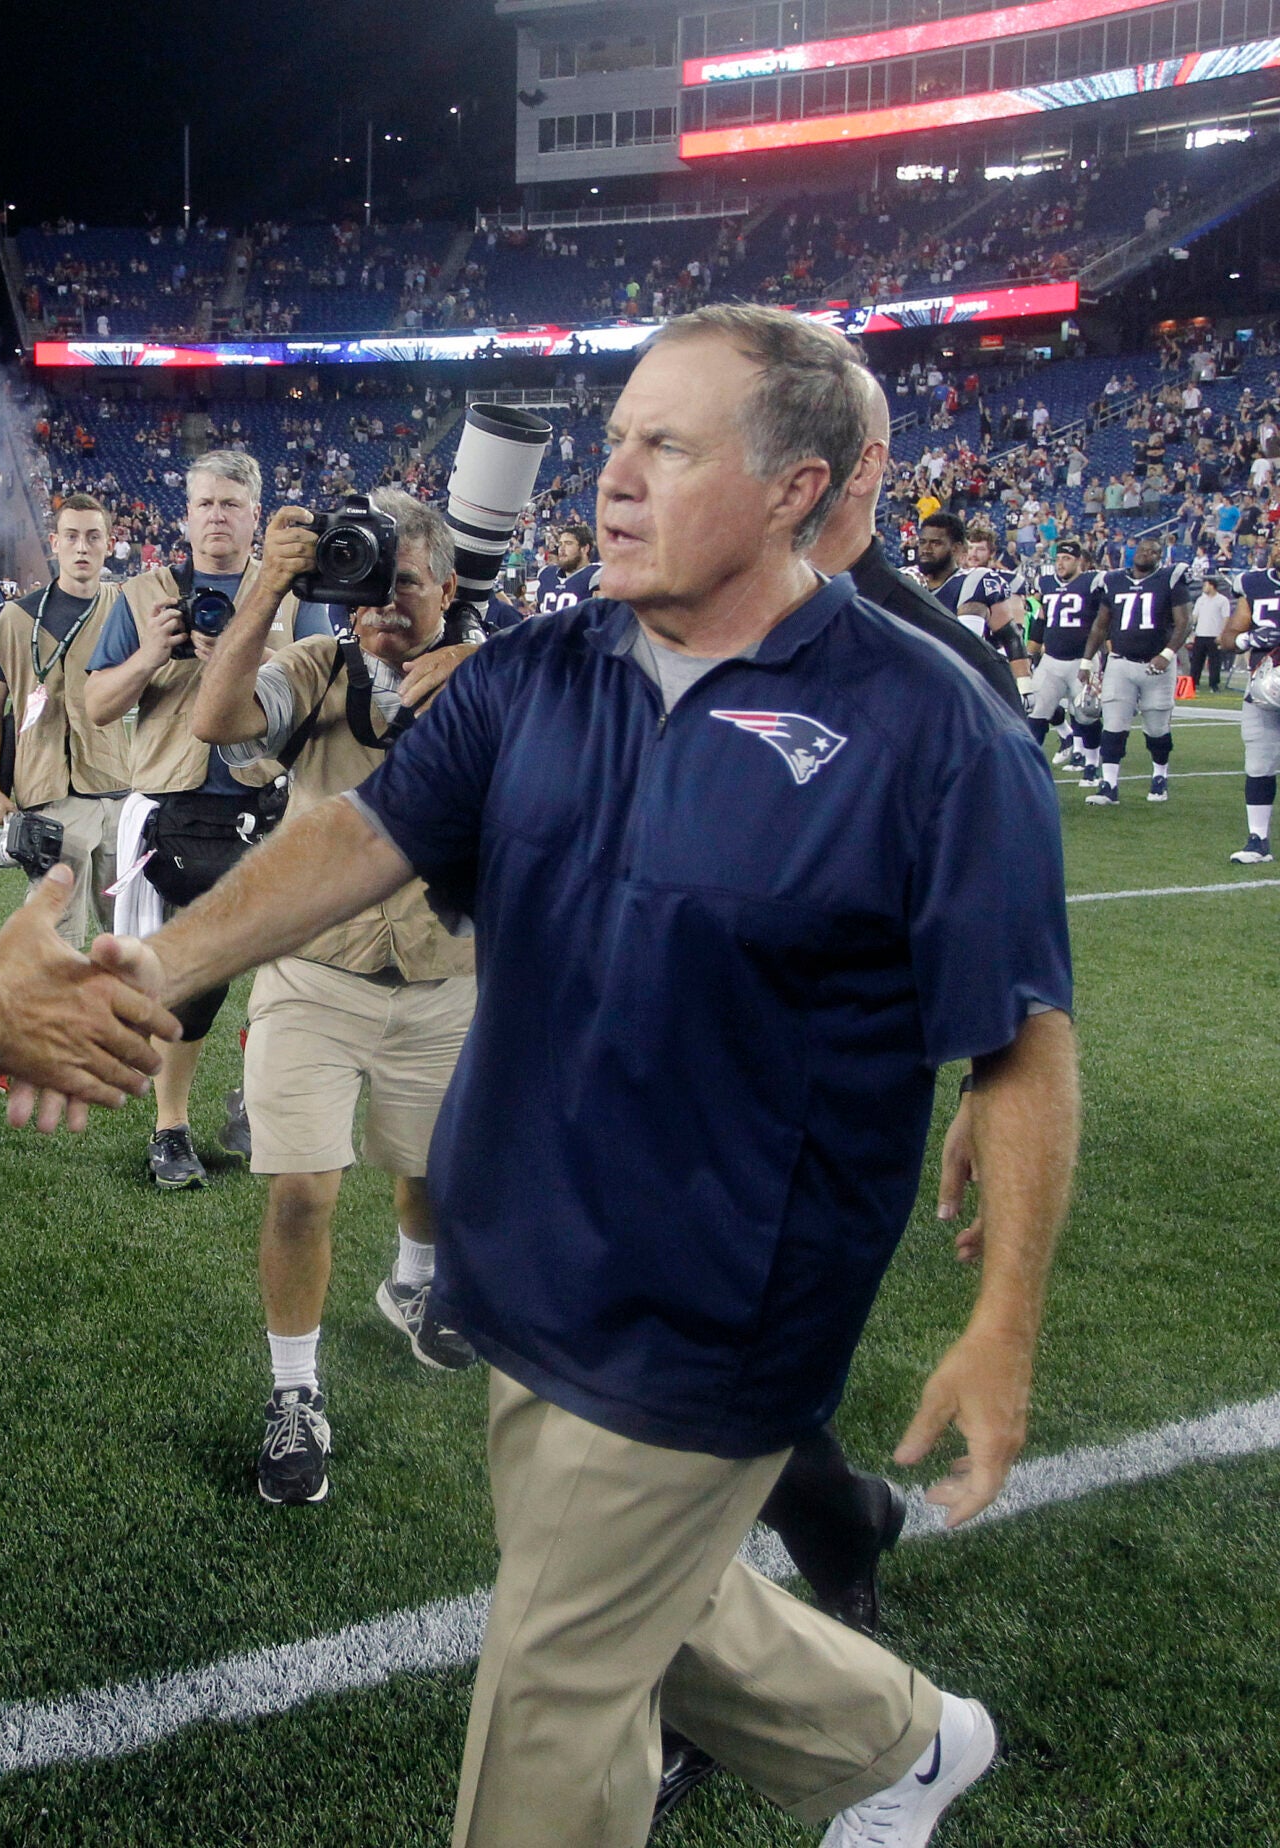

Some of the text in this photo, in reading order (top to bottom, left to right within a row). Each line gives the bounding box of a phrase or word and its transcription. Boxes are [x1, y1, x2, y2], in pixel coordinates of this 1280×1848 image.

[875, 296, 953, 315] PATRIOTS
[1042, 593, 1082, 628] 72
[1114, 592, 1155, 631] 71
